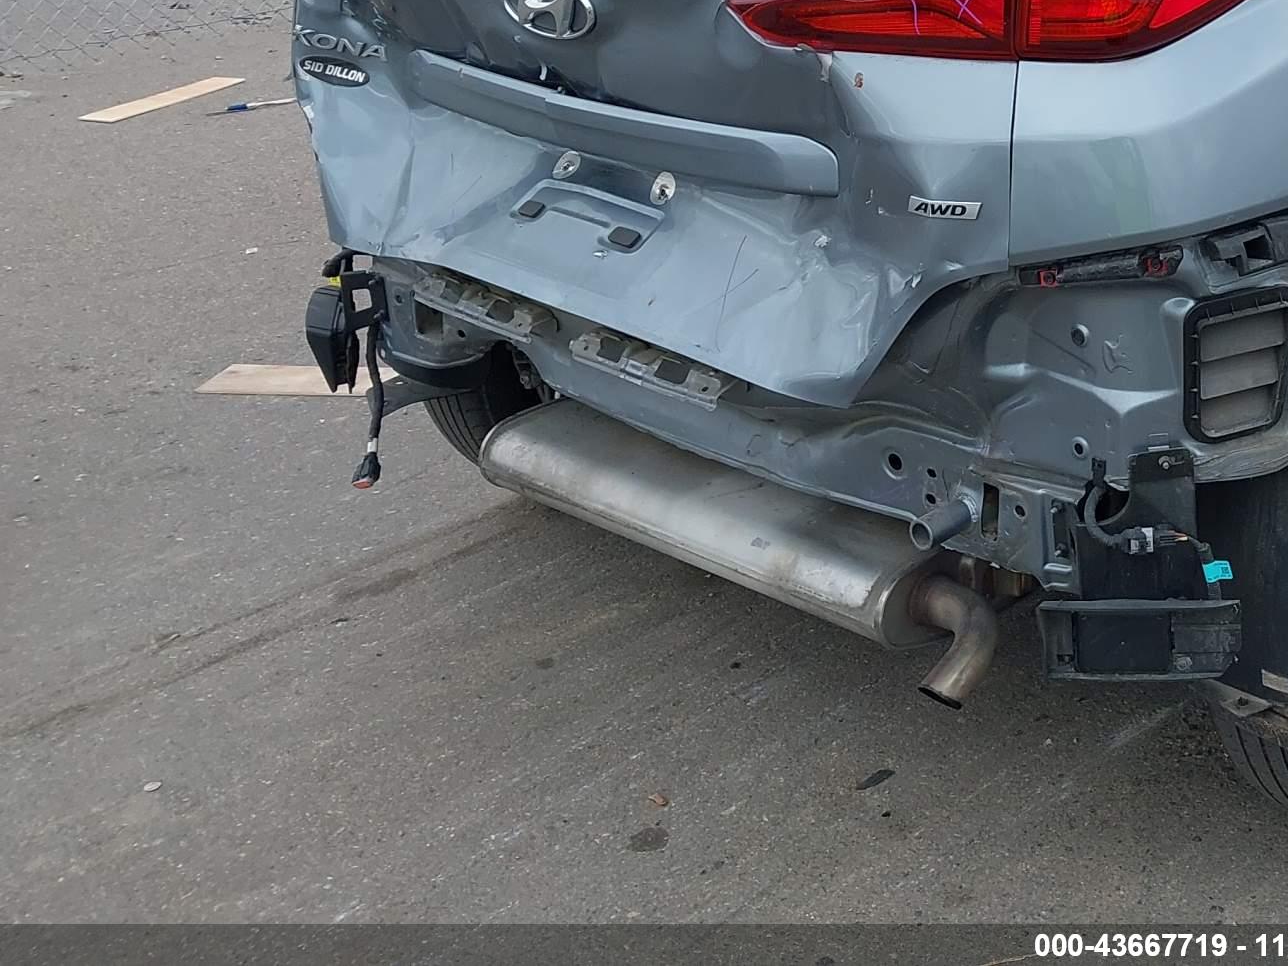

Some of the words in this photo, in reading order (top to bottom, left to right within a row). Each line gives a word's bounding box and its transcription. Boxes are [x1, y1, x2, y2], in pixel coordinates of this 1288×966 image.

[294, 24, 388, 62] KONA
[303, 60, 324, 73] SID
[325, 64, 366, 83] DILLON
[915, 202, 967, 216] AWD
